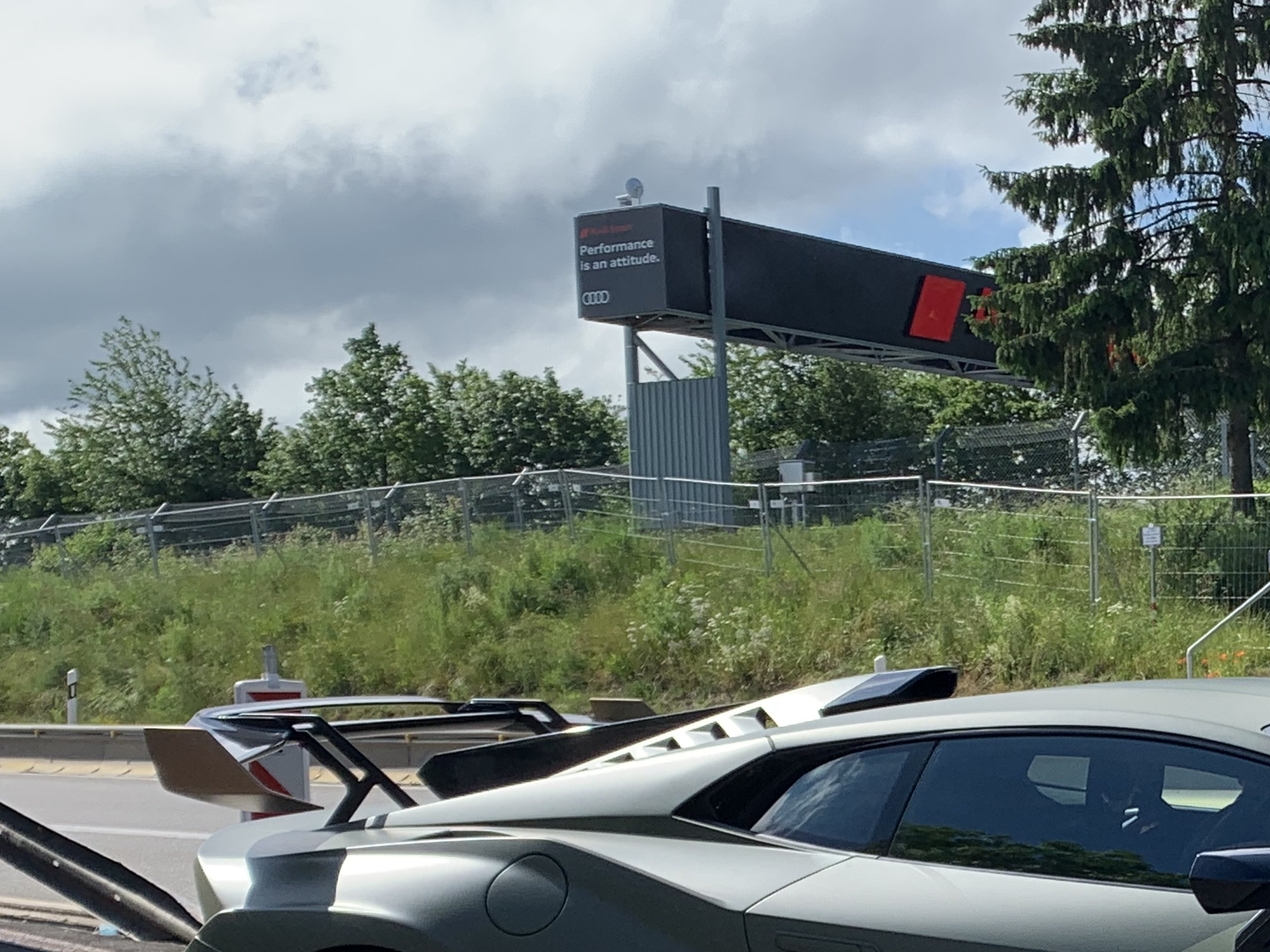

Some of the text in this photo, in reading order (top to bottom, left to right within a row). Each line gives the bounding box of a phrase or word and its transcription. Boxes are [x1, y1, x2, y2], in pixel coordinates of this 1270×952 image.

[580, 240, 654, 255] Performance
[580, 253, 660, 271] is an attitude.
